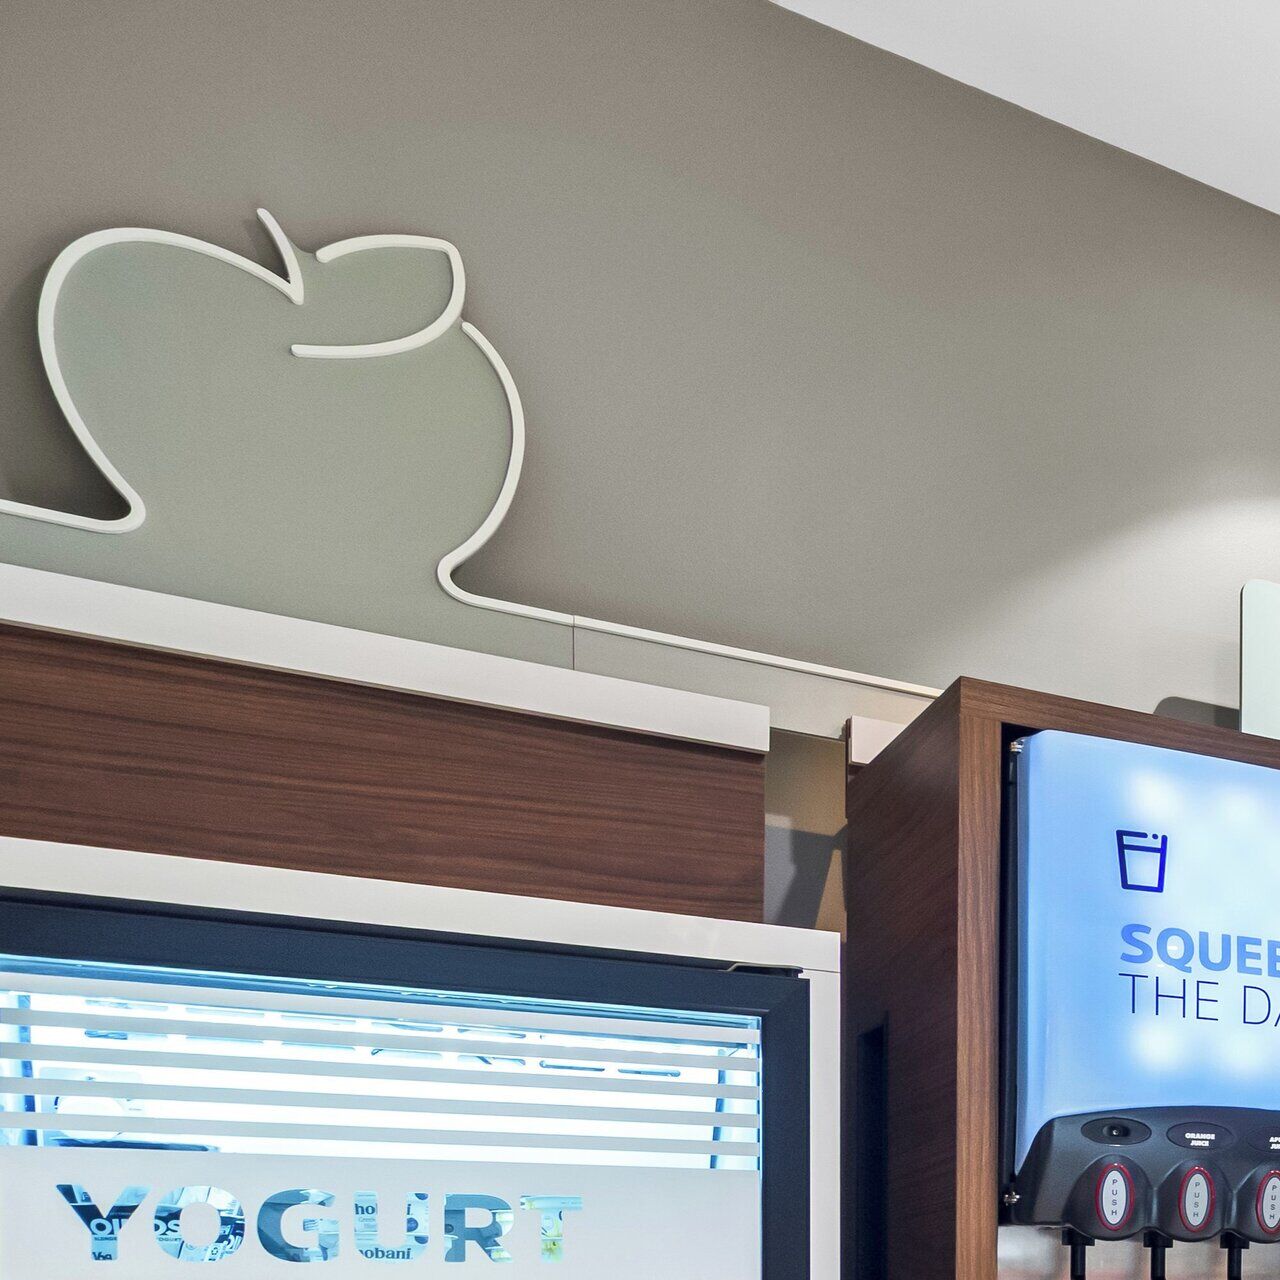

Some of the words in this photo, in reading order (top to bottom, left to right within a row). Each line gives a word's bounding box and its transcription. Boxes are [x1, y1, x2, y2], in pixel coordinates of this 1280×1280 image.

[1119, 973, 1219, 1021] THE
[56, 1184, 583, 1263] YOGURT
[1269, 1185, 1278, 1220] PUSH
